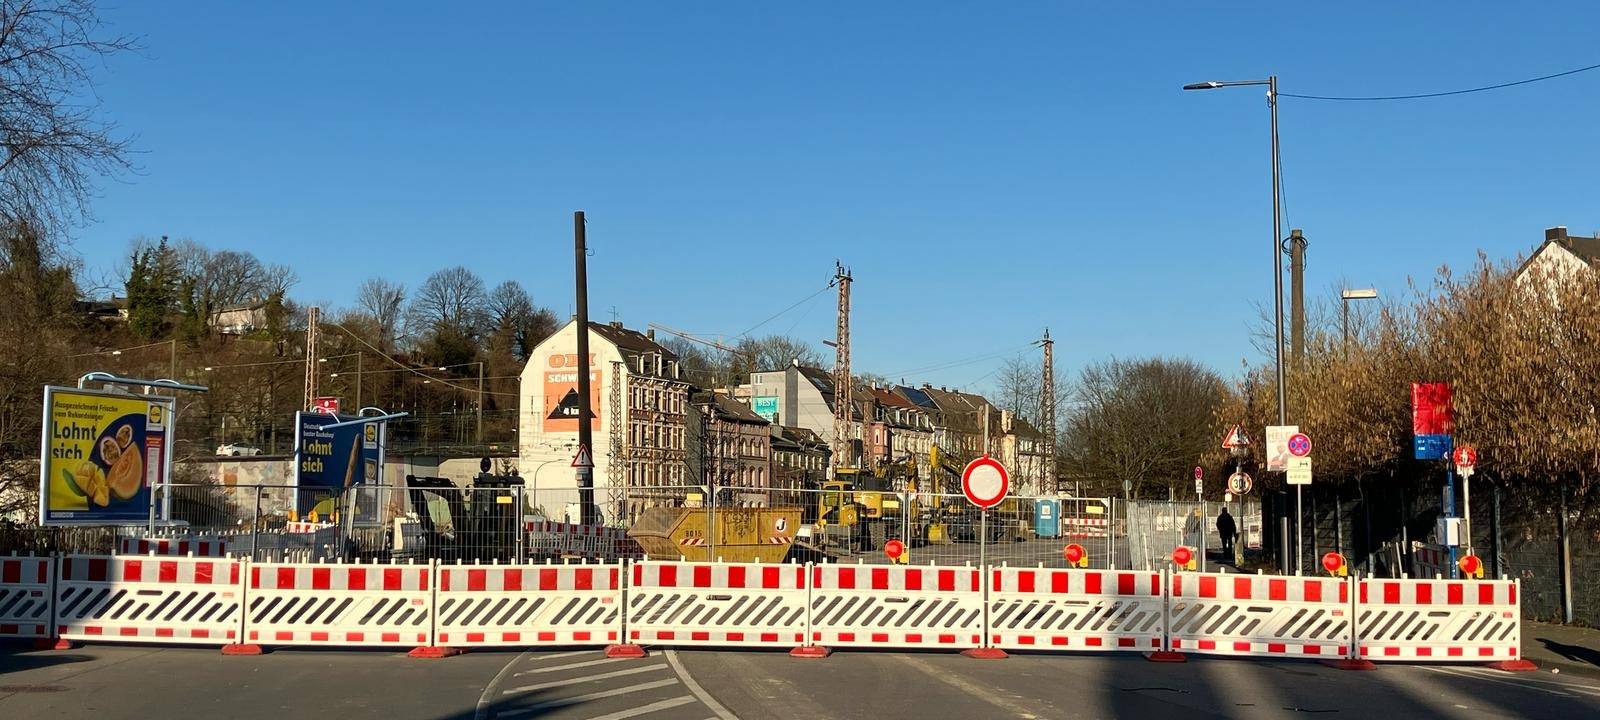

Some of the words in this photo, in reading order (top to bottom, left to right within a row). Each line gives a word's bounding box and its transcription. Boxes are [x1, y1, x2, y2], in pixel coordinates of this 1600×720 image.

[563, 407, 570, 415] 4
[53, 421, 97, 440] Lohnt
[52, 443, 82, 459] sich
[302, 439, 332, 455] Lohnt
[302, 457, 323, 472] sich
